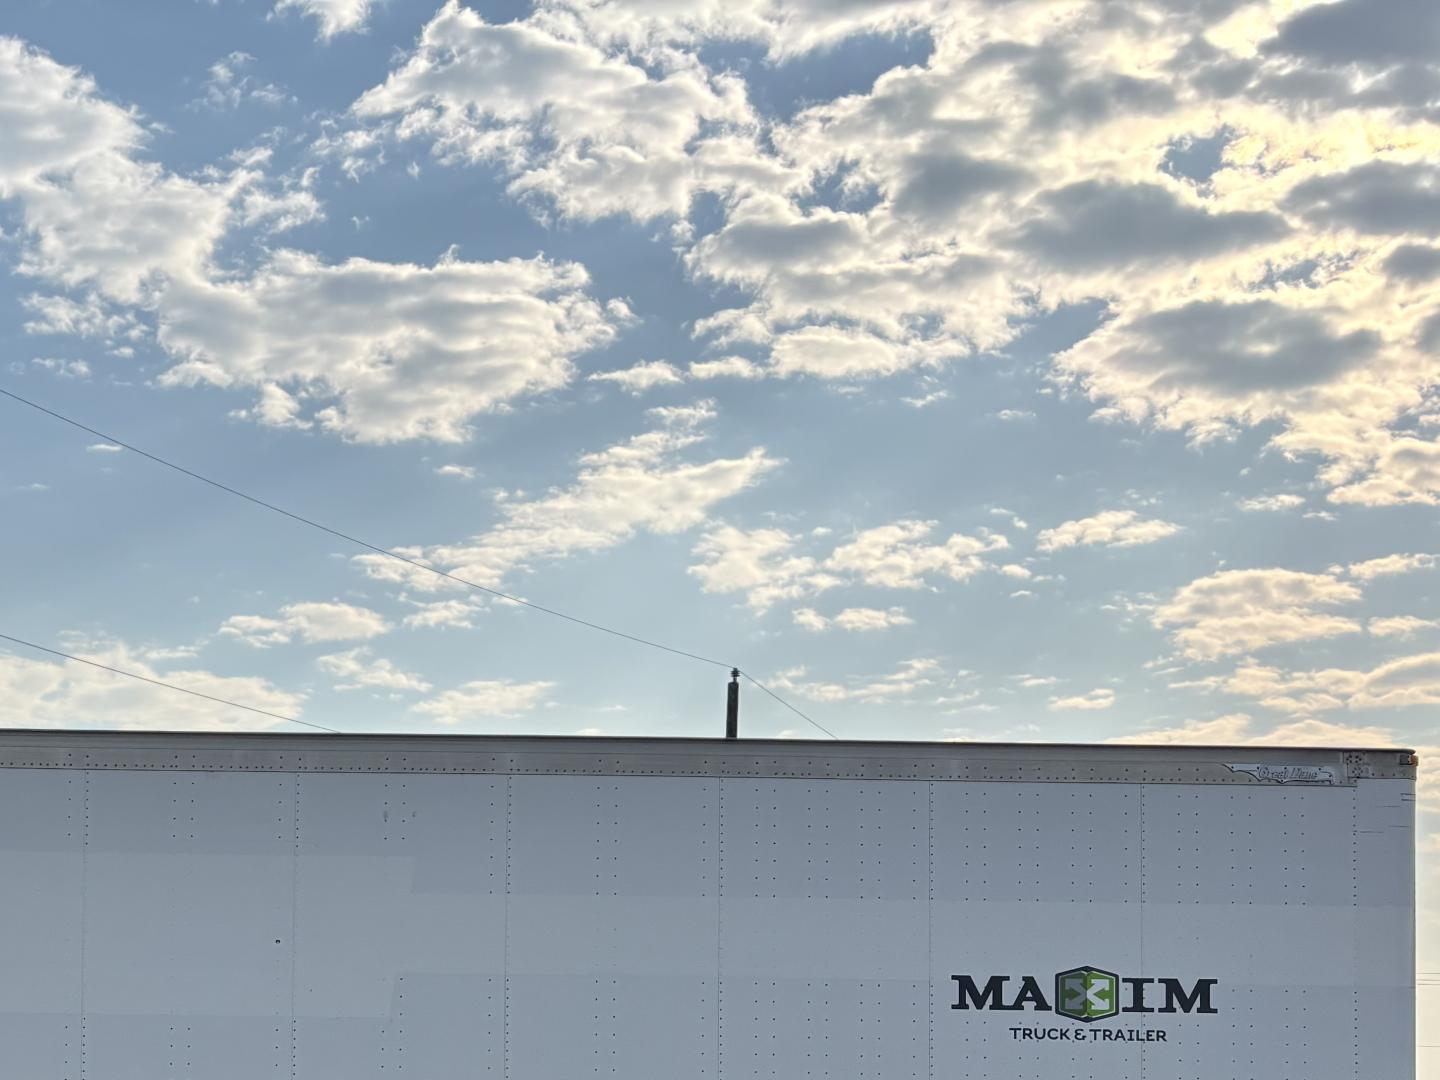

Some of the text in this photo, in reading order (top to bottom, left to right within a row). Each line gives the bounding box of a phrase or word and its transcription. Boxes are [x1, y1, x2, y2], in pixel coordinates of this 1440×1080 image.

[950, 966, 1218, 1023] MAXIM
[1009, 1027, 1167, 1042] TRUCK & TRAILER
